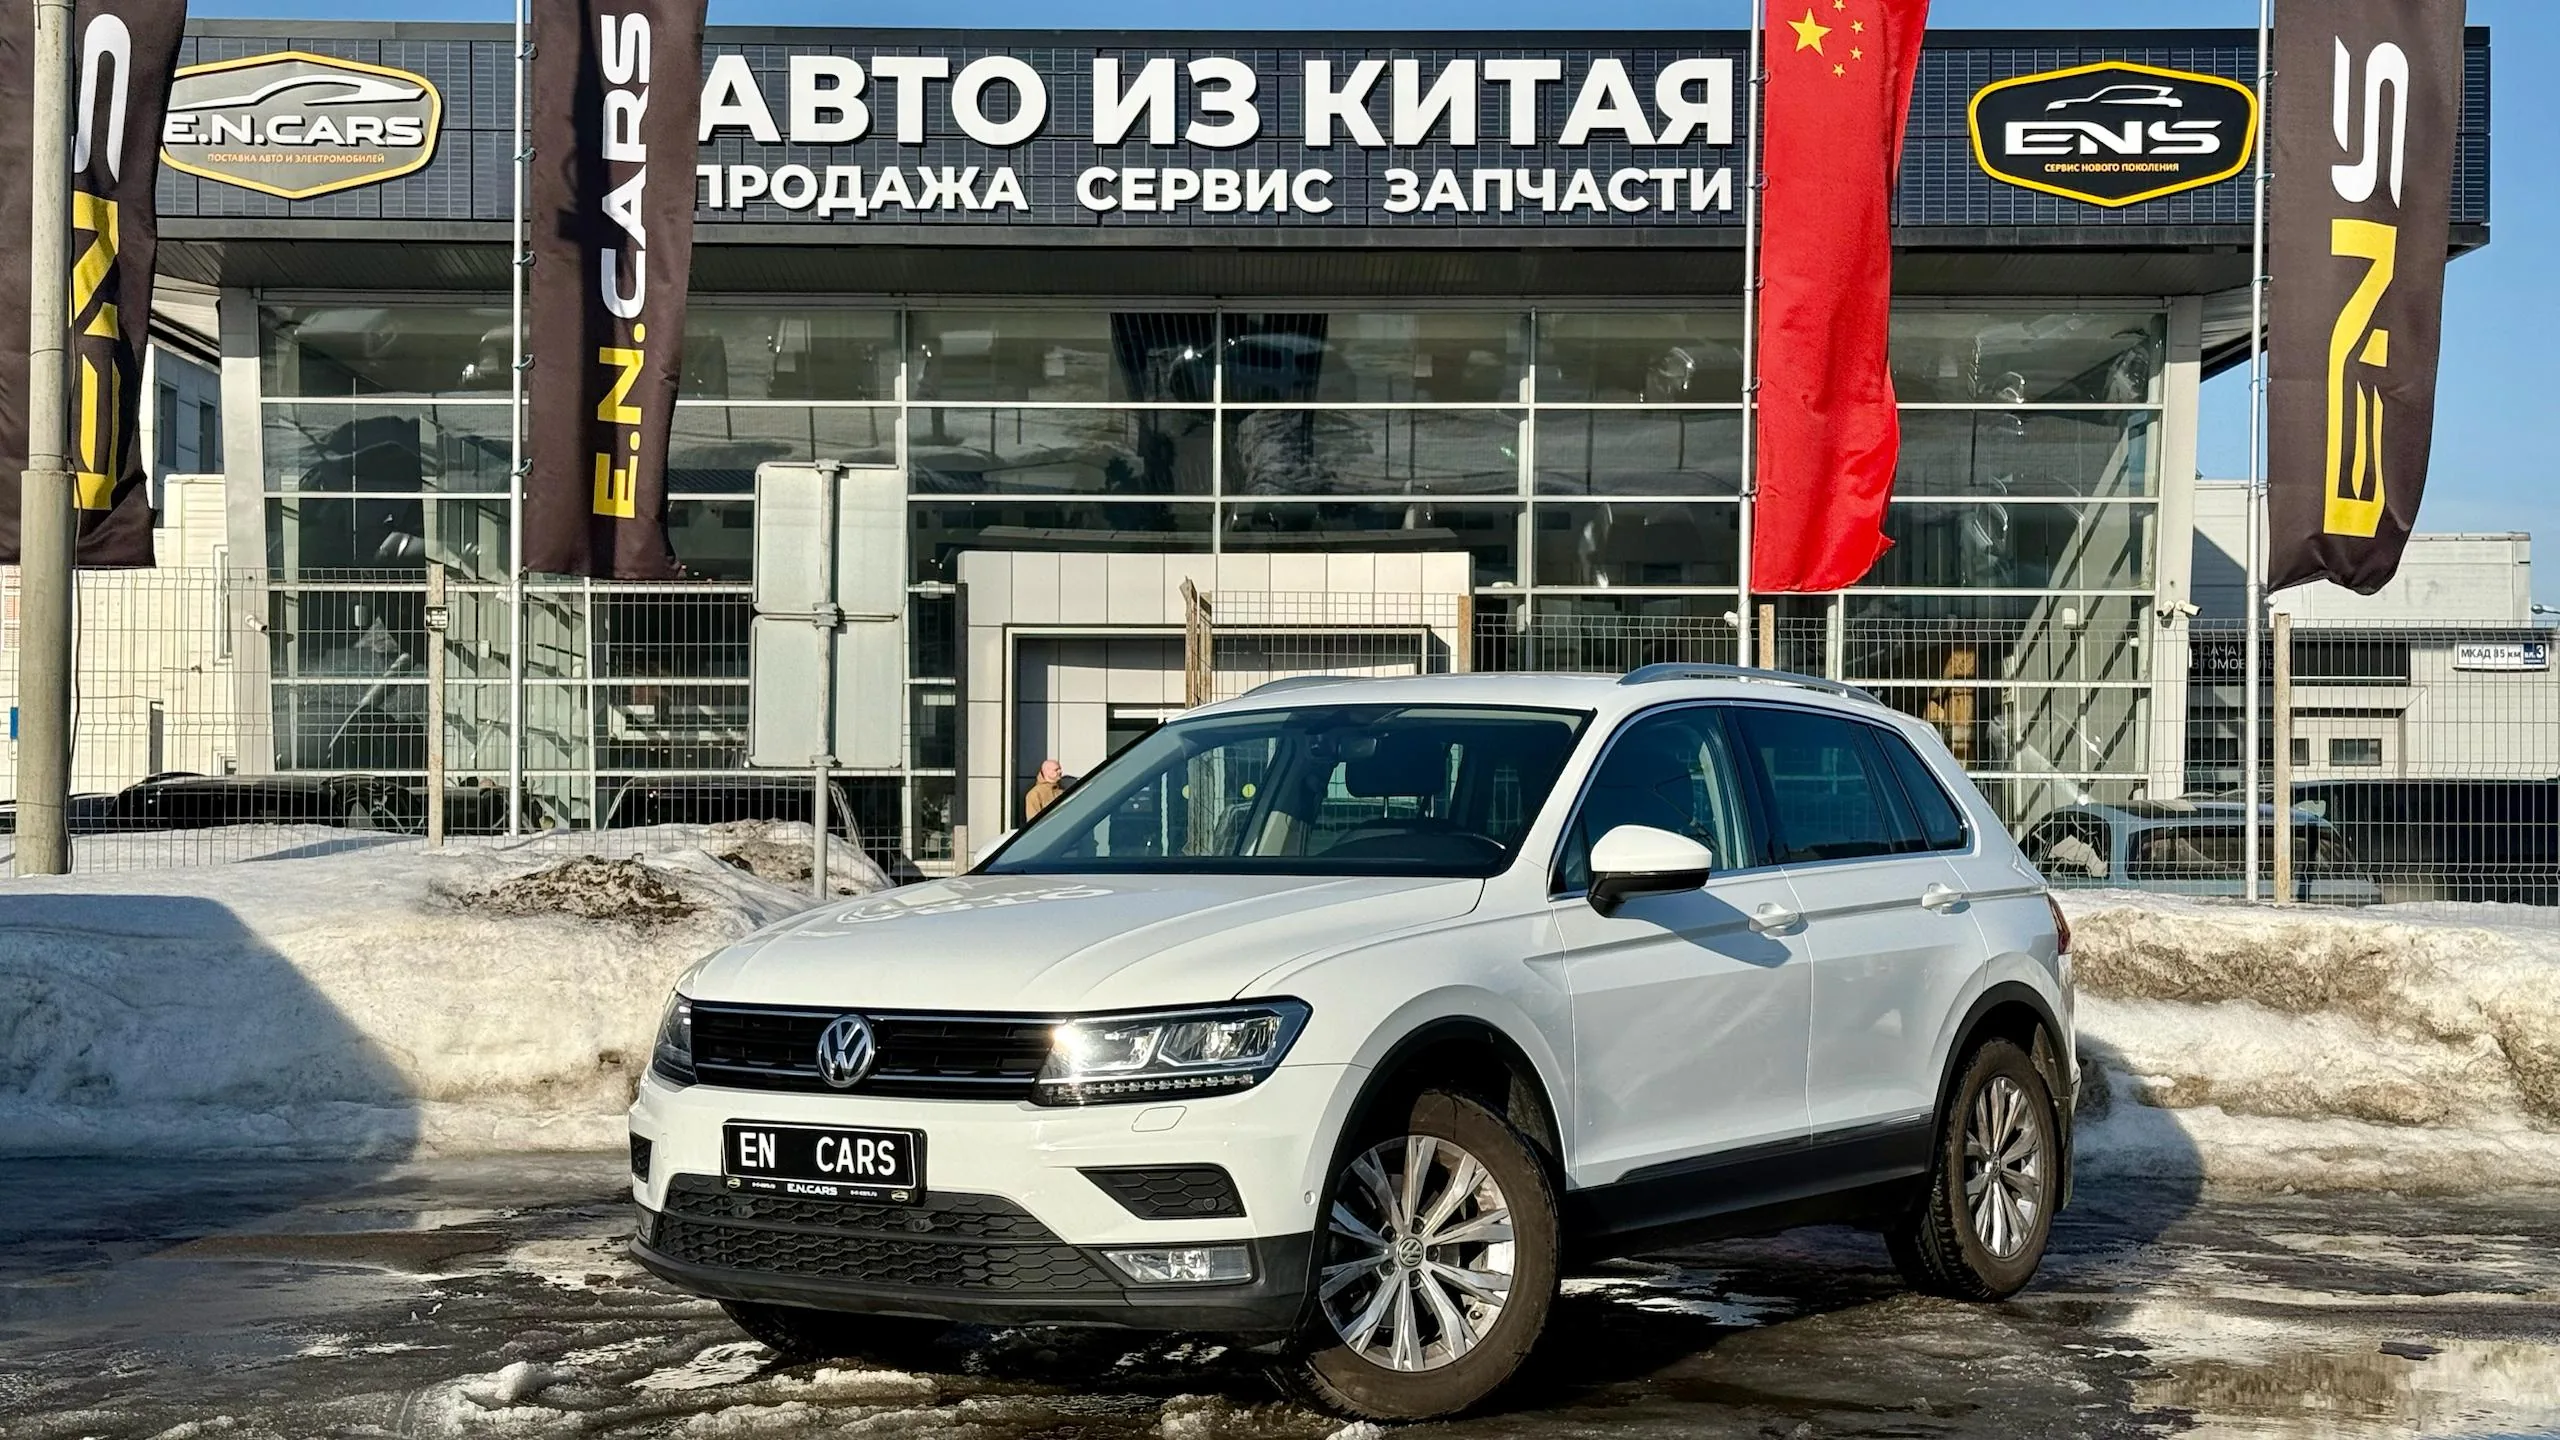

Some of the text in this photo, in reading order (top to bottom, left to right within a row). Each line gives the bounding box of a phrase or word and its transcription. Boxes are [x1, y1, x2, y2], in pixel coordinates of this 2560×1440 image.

[698, 54, 1733, 148] АВТО ИЗ КИТАЯ
[162, 112, 424, 145] E.N.CARS
[2004, 120, 2222, 155] ENS
[207, 152, 385, 164] ПОСТАВКА АВТО И ЭЛЕКТРОМОБИЛЕЙ
[2044, 162, 2179, 173] СЕРВИС НОВОГО ПОКОЛЕНИЯ
[696, 164, 1733, 218] ПРОДАЖА СЕРВИС ЗАПЧАСТИ
[593, 12, 652, 518] E.N.CARS
[2461, 649, 2491, 660] МКАД
[2536, 644, 2545, 659] 3
[739, 1131, 896, 1176] EN CARS
